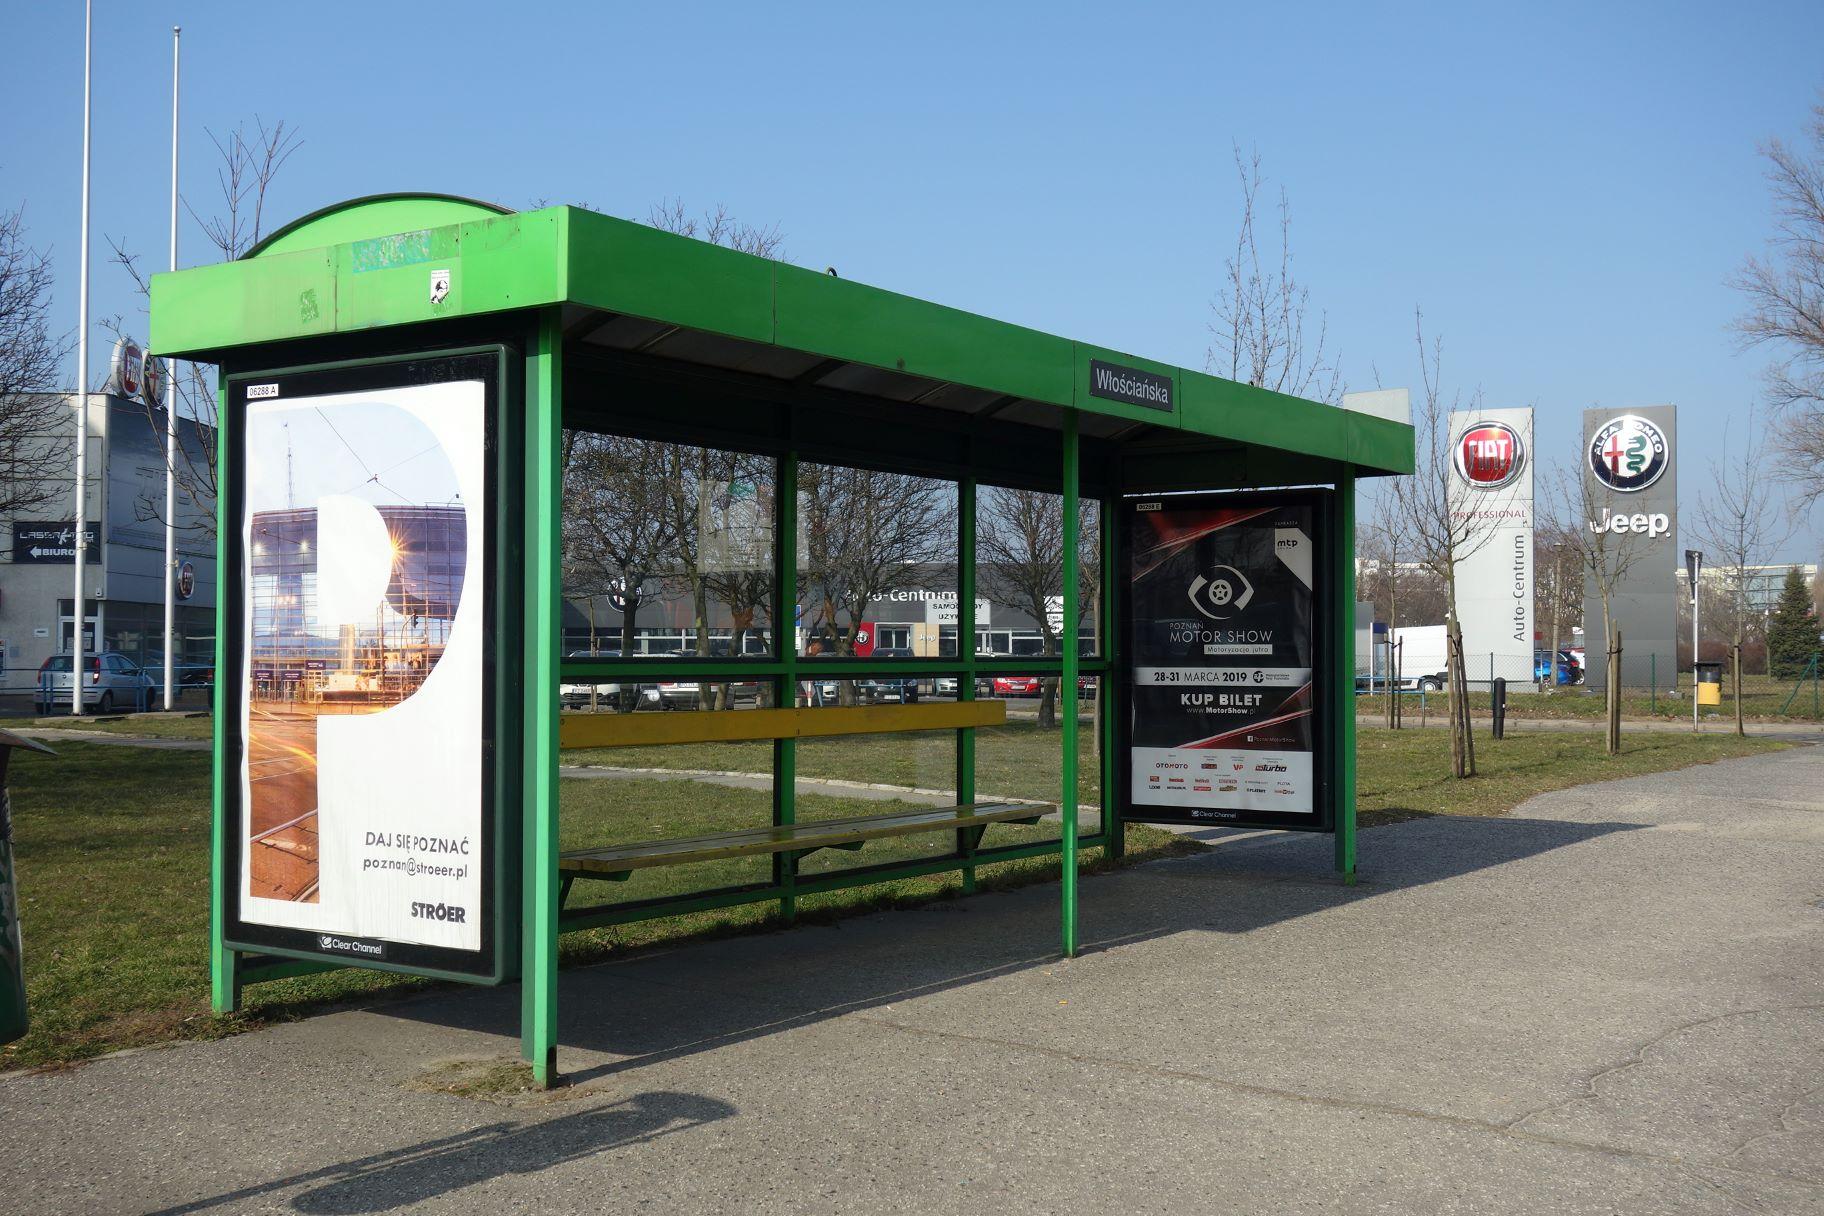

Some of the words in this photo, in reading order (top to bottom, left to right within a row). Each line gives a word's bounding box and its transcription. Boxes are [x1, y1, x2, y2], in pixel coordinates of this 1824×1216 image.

[249, 386, 269, 397] 06288
[271, 385, 276, 395] A
[1096, 367, 1169, 403] Włościańska
[1594, 426, 1619, 456] ALFA
[1631, 421, 1663, 453] OMEO
[1468, 439, 1509, 471] FIAT
[1452, 510, 1527, 519] PROFESSIONAL
[1590, 508, 1668, 539] Jeep
[42, 548, 76, 556] BIURO
[1277, 539, 1298, 547] mtp
[1513, 535, 1525, 642] Auto-Centrum
[1169, 630, 1222, 643] MOTOR
[1227, 630, 1273, 643] SHOW
[1154, 672, 1180, 682] 28-31
[1184, 672, 1220, 682] MARCA
[1222, 672, 1247, 682] 2019
[1180, 693, 1214, 706] KUP
[1219, 693, 1263, 706] BILET
[1186, 707, 1256, 715] www.MotorShow.pl
[365, 831, 392, 848] DAJ
[396, 833, 411, 854] SIĘ
[413, 836, 469, 855] POZNAĆ
[363, 857, 468, 880] poznan@stroeer.pl
[411, 901, 466, 923] STRÖER
[332, 938, 352, 951] Clear
[352, 941, 382, 955] Channel
